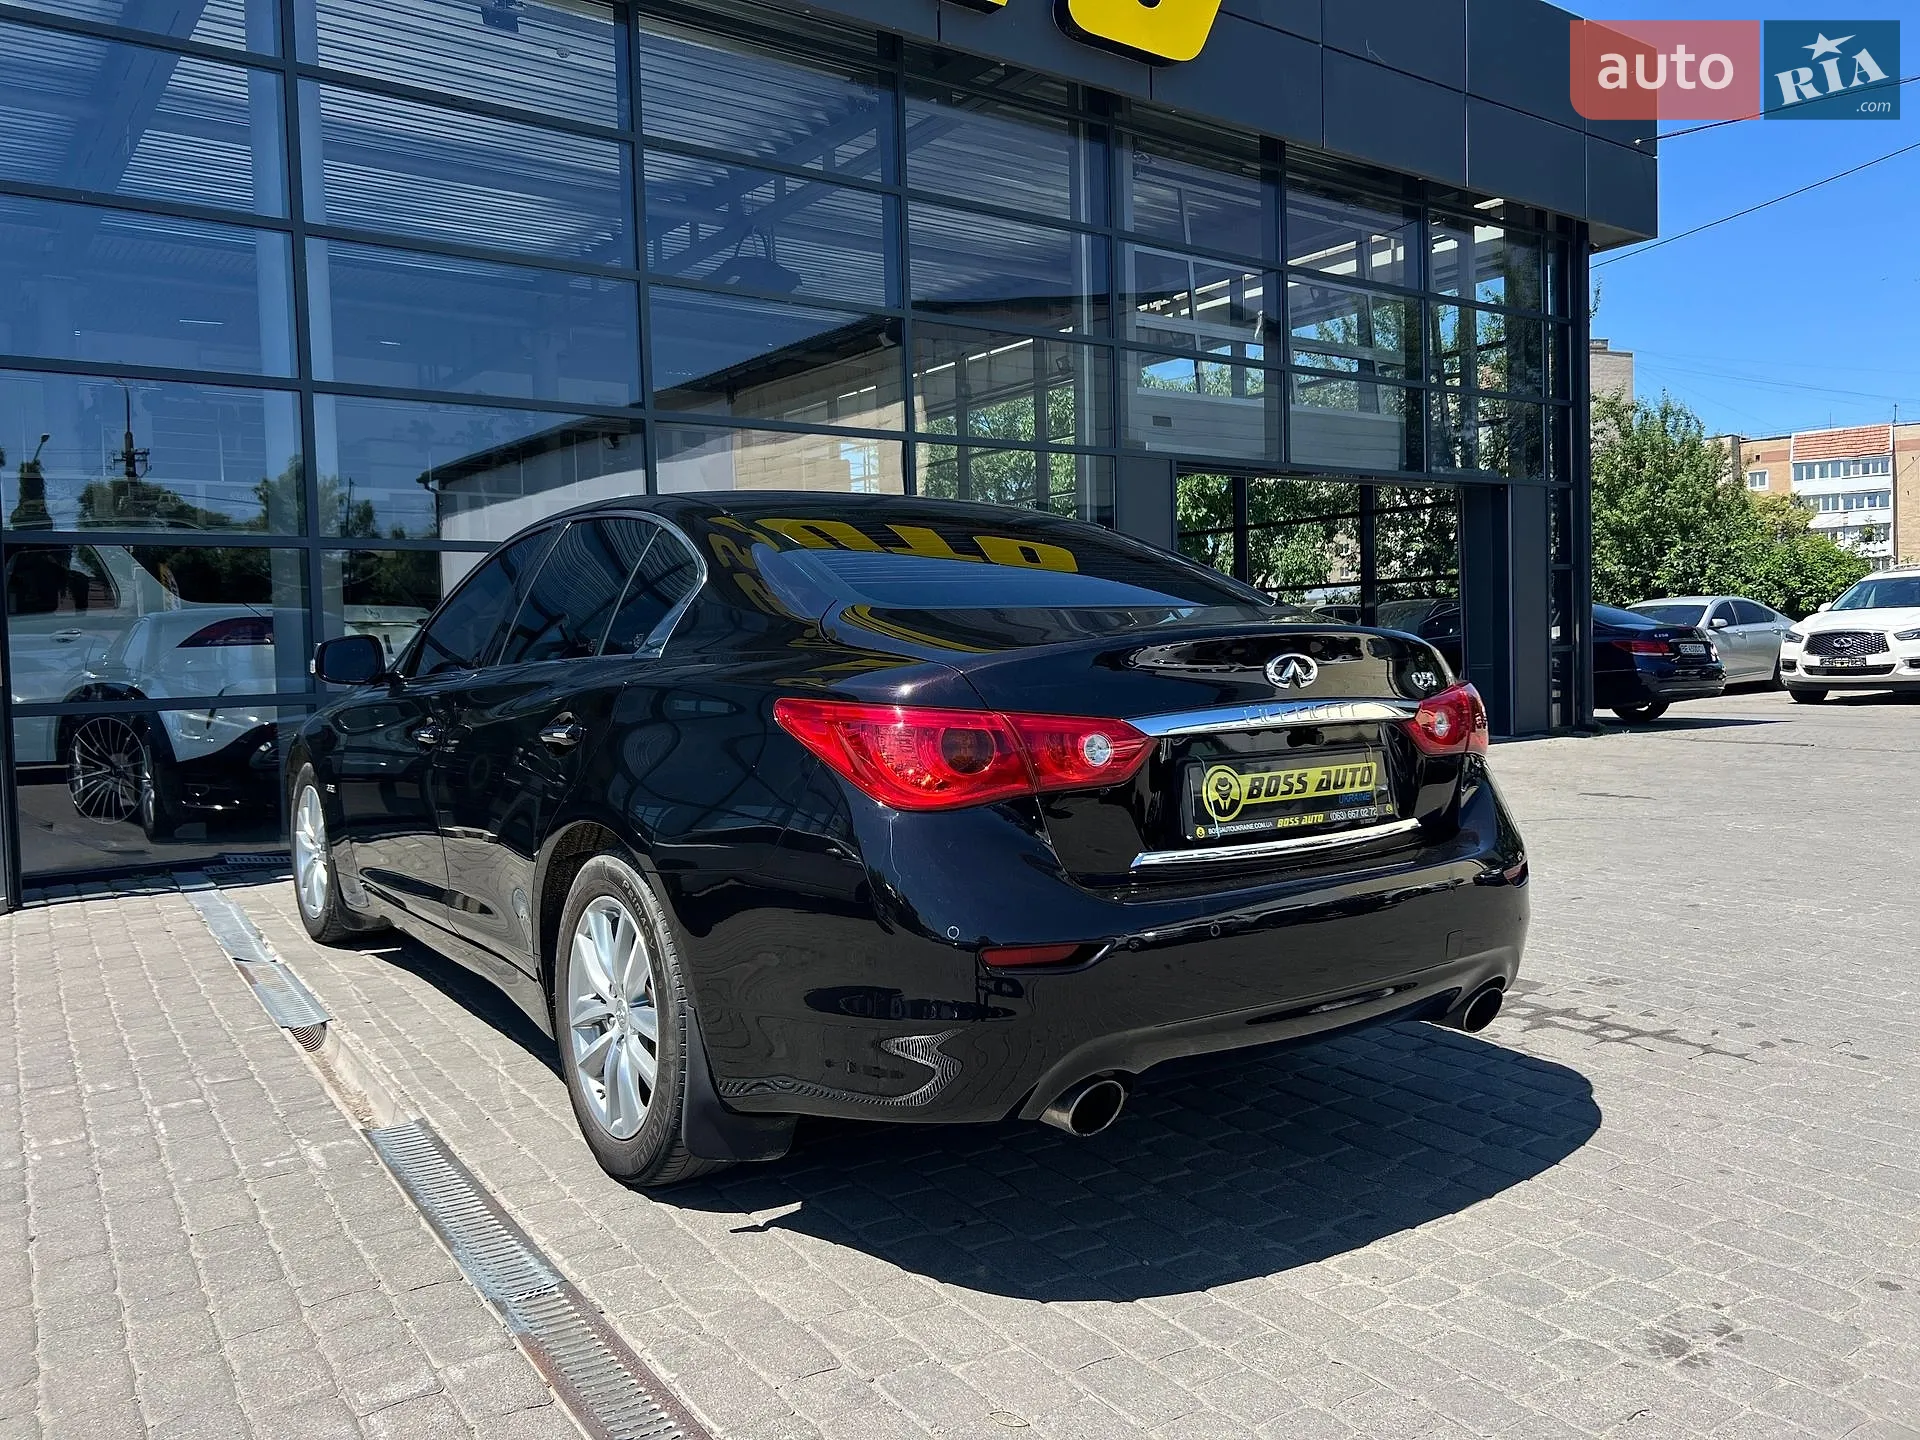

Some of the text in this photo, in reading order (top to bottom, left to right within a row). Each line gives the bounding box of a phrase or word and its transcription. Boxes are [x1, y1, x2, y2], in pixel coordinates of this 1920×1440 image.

[1246, 766, 1374, 800] BOSS AUTO
[1338, 792, 1371, 803] UKRAINE
[1277, 816, 1299, 828] BOSS
[1301, 813, 1324, 825] AUTO
[622, 880, 656, 950] PRIMACY
